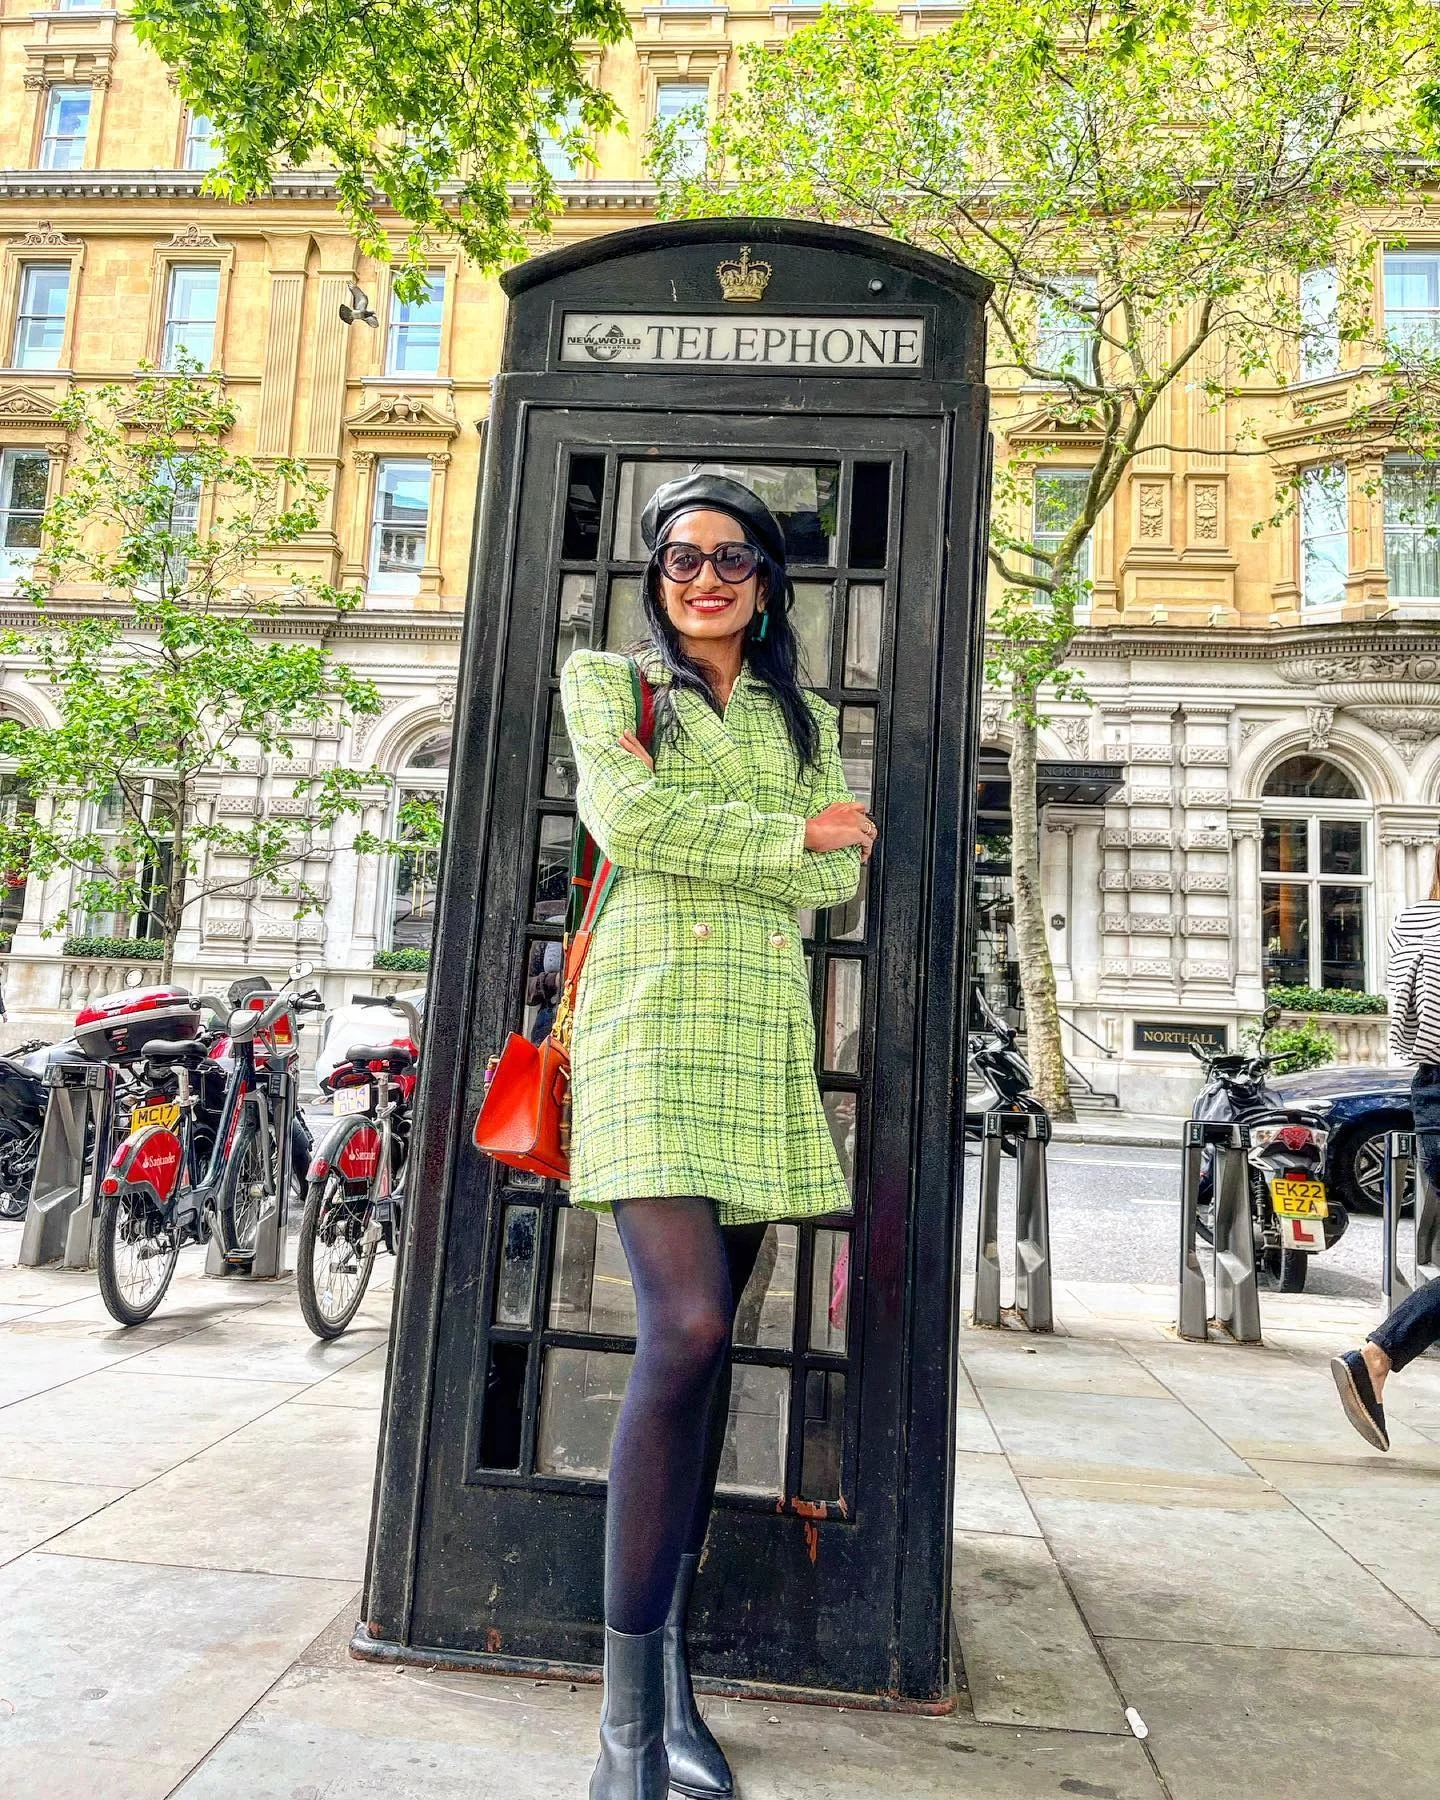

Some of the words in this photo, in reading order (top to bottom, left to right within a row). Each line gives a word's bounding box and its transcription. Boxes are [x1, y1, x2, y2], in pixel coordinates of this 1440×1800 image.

[567, 336, 595, 344] NEW
[598, 337, 641, 345] WORLD
[647, 326, 920, 364] TELEPHONE
[1042, 766, 1117, 778] NORTHALL
[1143, 1030, 1218, 1045] NORTHALL
[138, 1105, 174, 1124] MC17
[149, 1152, 176, 1168] Santander
[1275, 1182, 1323, 1199] EK22
[1283, 1198, 1318, 1214] EZA
[1292, 1219, 1315, 1243] L
